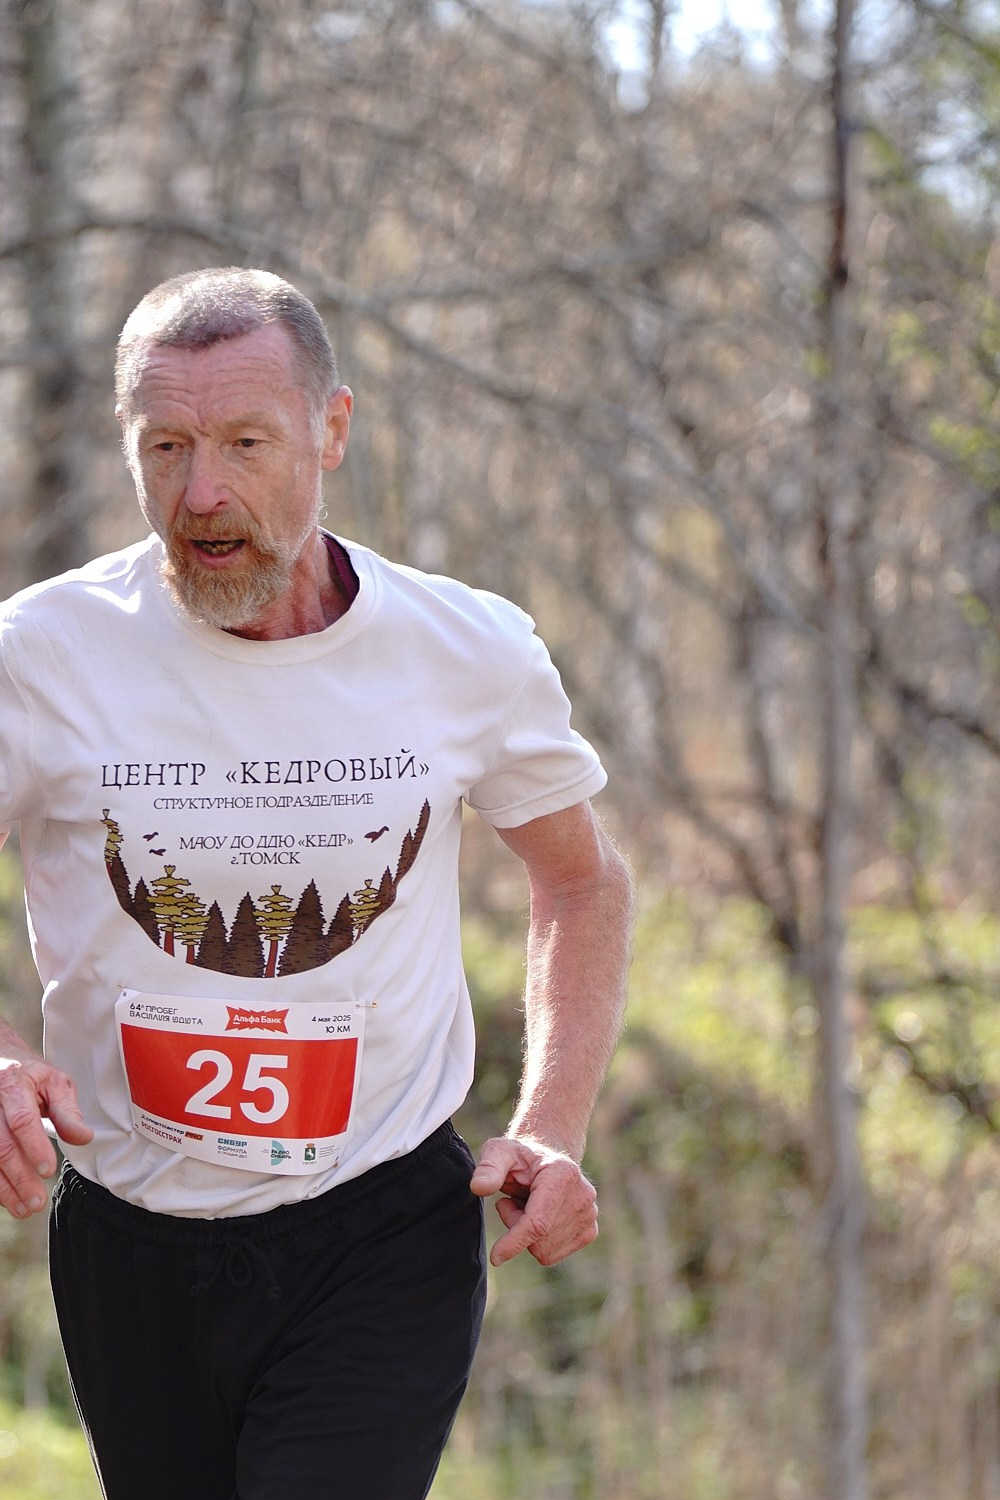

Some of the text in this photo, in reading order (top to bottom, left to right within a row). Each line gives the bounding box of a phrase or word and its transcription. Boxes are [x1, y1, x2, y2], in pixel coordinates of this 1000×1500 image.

[101, 748, 430, 791] ЦЕНТР «КЕДРОВЫЙ»
[153, 793, 374, 810] СТРУКТУРНОЕ ПОДРАЗДЕЛЕНИЕ
[179, 833, 354, 850] МАОУ ДО ДДЮ «КЕДР»
[230, 851, 301, 865] г.ТОМСК
[129, 1010, 170, 1022] ВАСИЛИЯ
[145, 1005, 178, 1015] ПРОБЕГ
[232, 1014, 282, 1025] Альфа Банк
[332, 1014, 351, 1022] 2025
[336, 1025, 351, 1033] КМ
[185, 1049, 289, 1124] 25
[217, 1137, 248, 1148] СИБУР
